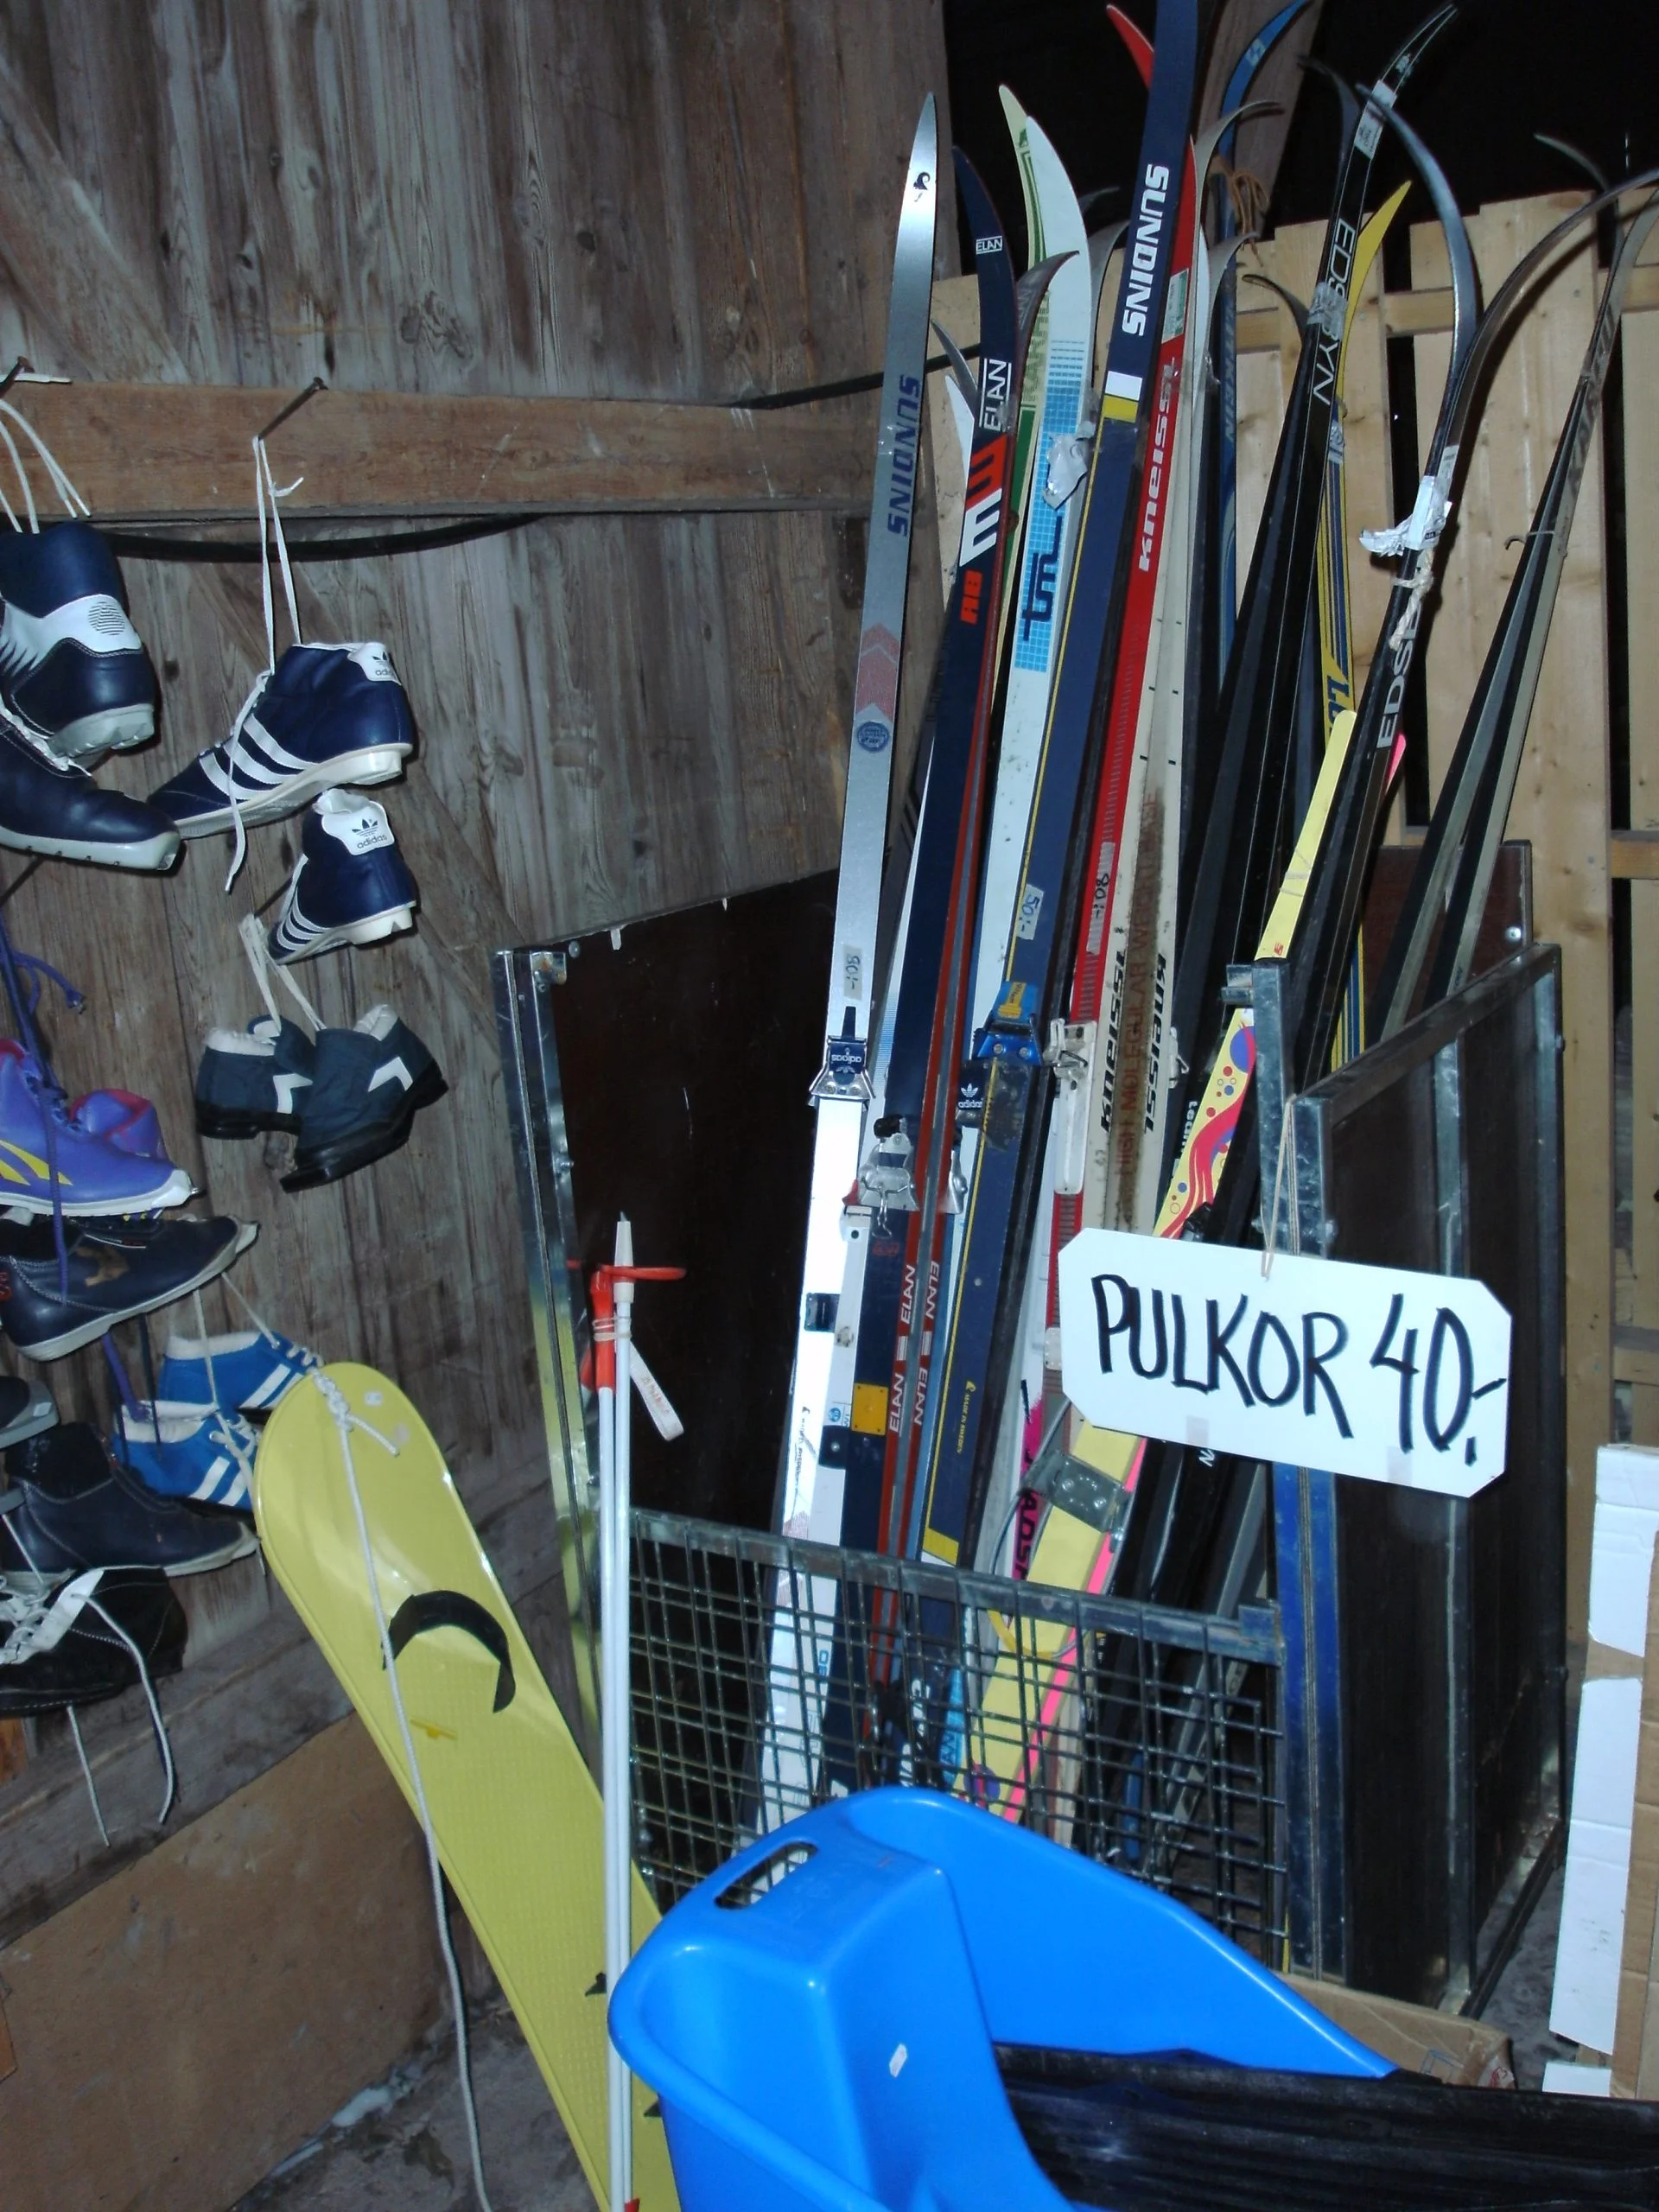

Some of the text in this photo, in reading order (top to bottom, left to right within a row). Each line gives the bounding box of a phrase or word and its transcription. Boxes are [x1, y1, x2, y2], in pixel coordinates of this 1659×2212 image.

[976, 237, 1002, 252] ELAN
[1122, 163, 1169, 337] SUNDINS
[983, 359, 1007, 431] ELAN
[887, 374, 920, 537] SUNDINS
[357, 835, 387, 849] adidas
[831, 1053, 861, 1064] adidas
[900, 1264, 916, 1325] ELAN
[925, 1261, 941, 1320] ELAN
[1090, 1274, 1354, 1439] PULKOR
[889, 1373, 906, 1433] ELAN
[914, 1367, 928, 1425] ELAN
